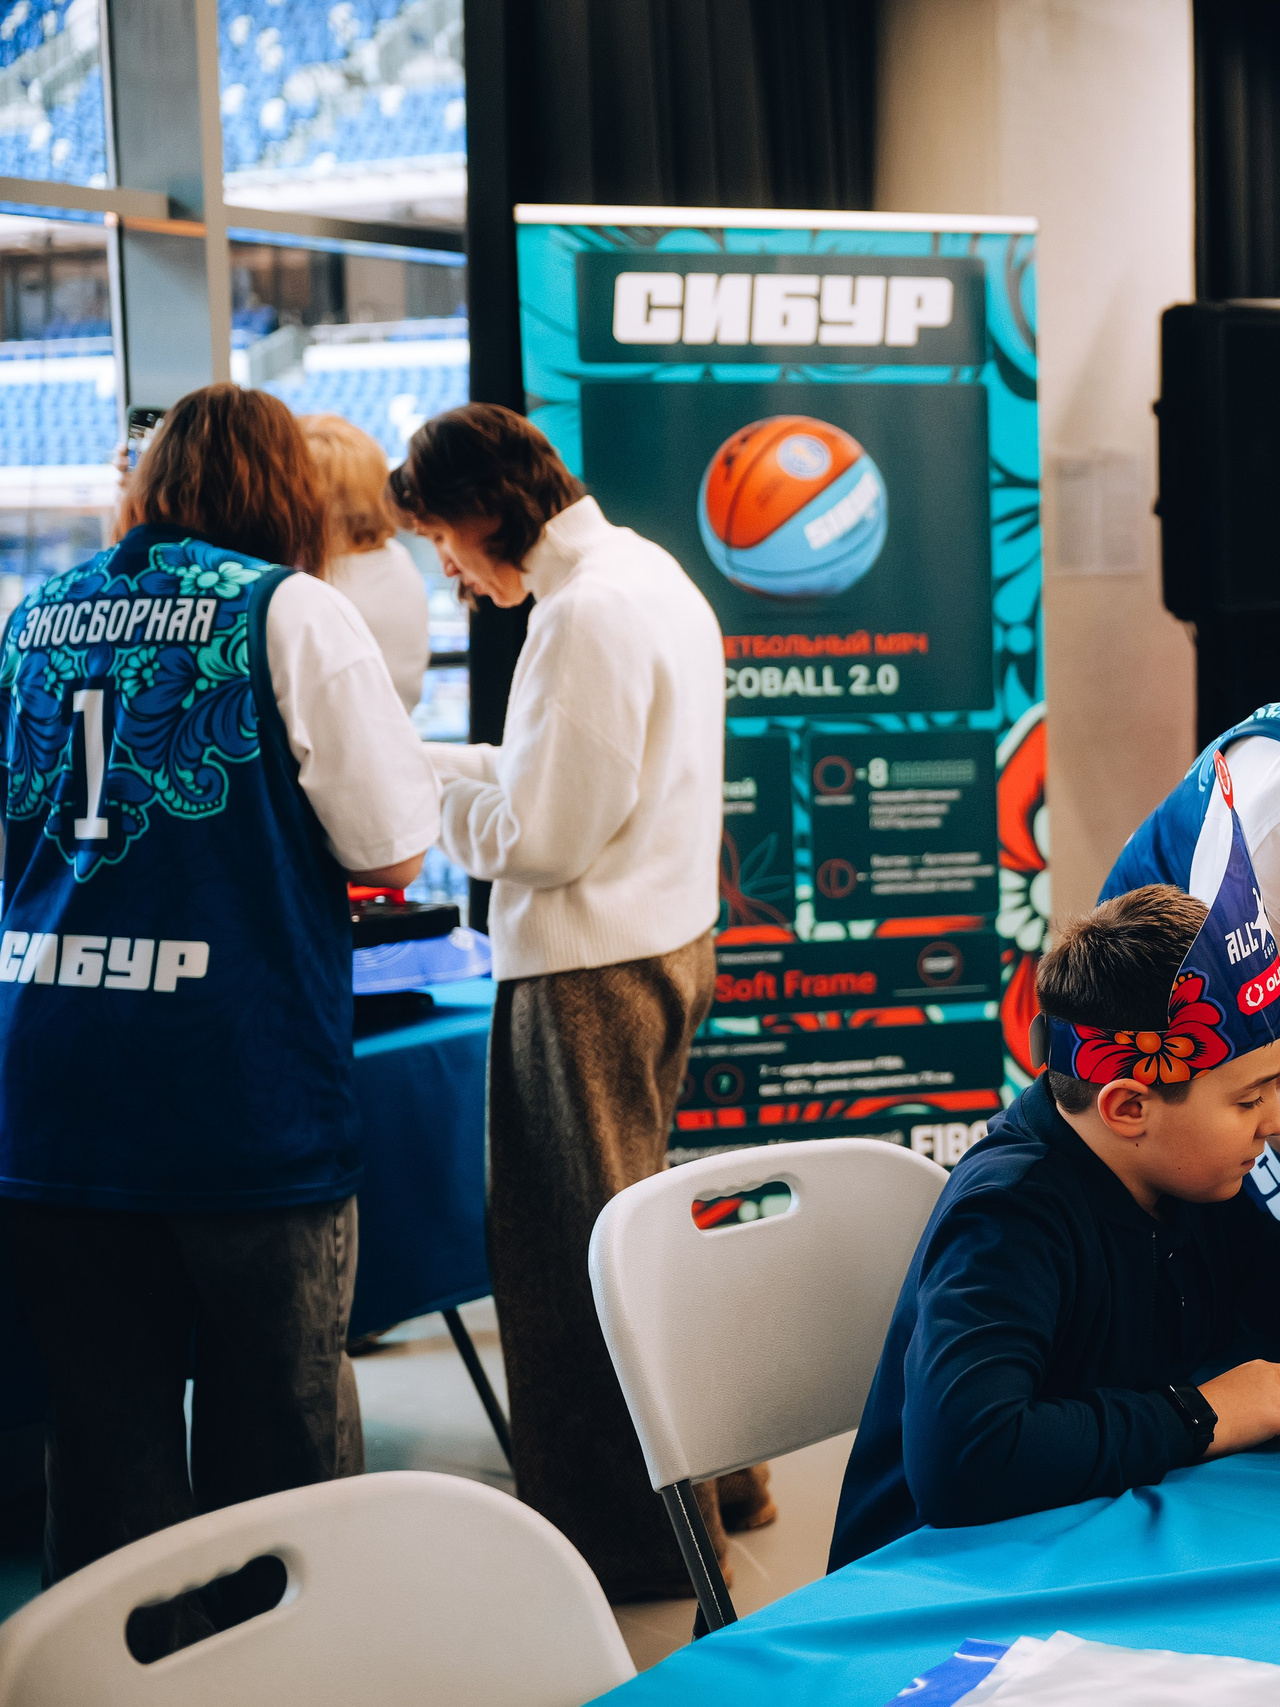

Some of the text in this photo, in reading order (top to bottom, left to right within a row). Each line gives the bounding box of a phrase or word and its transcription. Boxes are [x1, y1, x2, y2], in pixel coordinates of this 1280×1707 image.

[612, 271, 954, 347] СИБУР
[18, 597, 217, 650] ЭКОСБОРНАЯ
[848, 663, 900, 696] 2.0
[72, 688, 109, 840] 1
[1224, 921, 1260, 965] ALL
[716, 969, 878, 1002] Soft Frame
